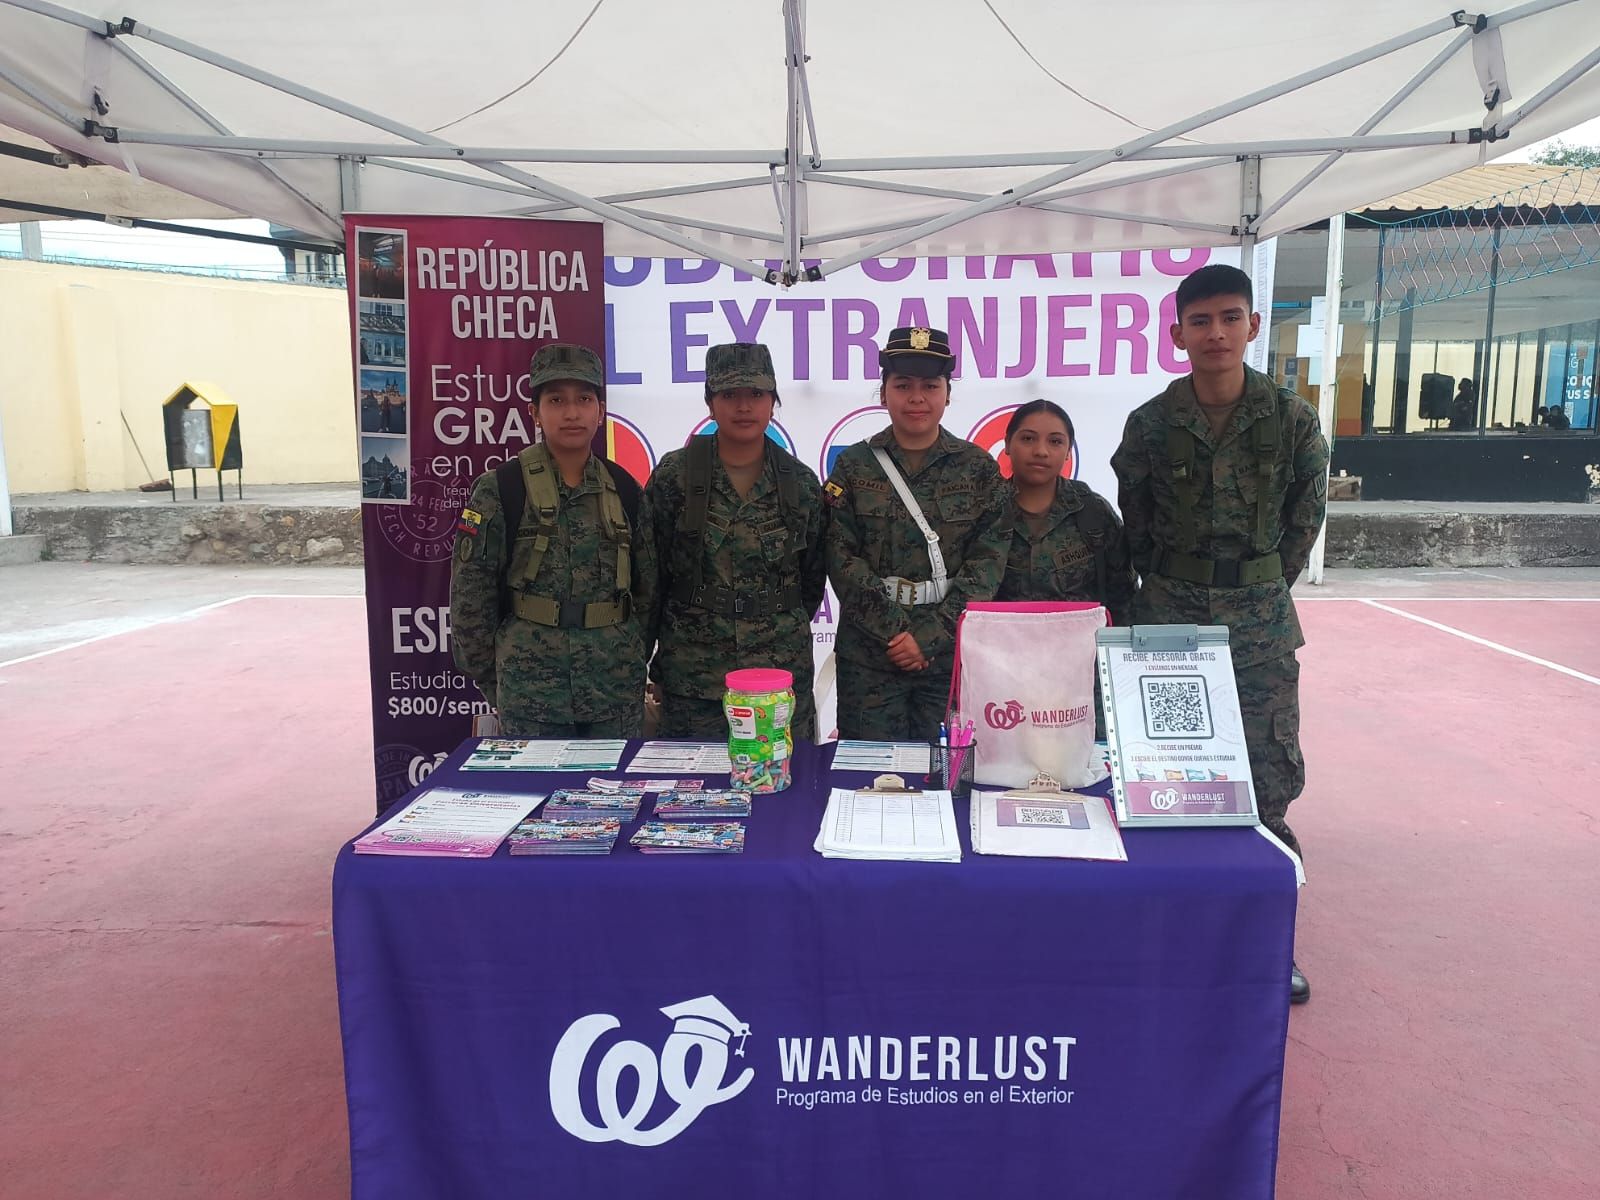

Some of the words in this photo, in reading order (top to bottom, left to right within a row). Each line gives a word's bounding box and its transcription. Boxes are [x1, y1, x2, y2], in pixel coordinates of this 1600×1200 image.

[416, 240, 589, 292] REPÚBLICA
[452, 295, 559, 340] CHECA
[605, 303, 643, 385] L
[431, 455, 473, 477] en
[443, 485, 471, 498] (requ
[391, 606, 452, 654] ESP
[1122, 653, 1149, 662] RECIBE
[1189, 652, 1216, 662] GRATIS
[390, 670, 466, 690] Estudia
[1031, 704, 1089, 724] WANDERLUST
[778, 1035, 1077, 1082] WANDERLUST
[776, 1087, 857, 1111] Programa
[861, 1085, 882, 1102] de
[887, 1086, 959, 1105] Estudios
[963, 1090, 984, 1104] en
[989, 1086, 1004, 1104] el
[1009, 1085, 1075, 1105] Exterior
